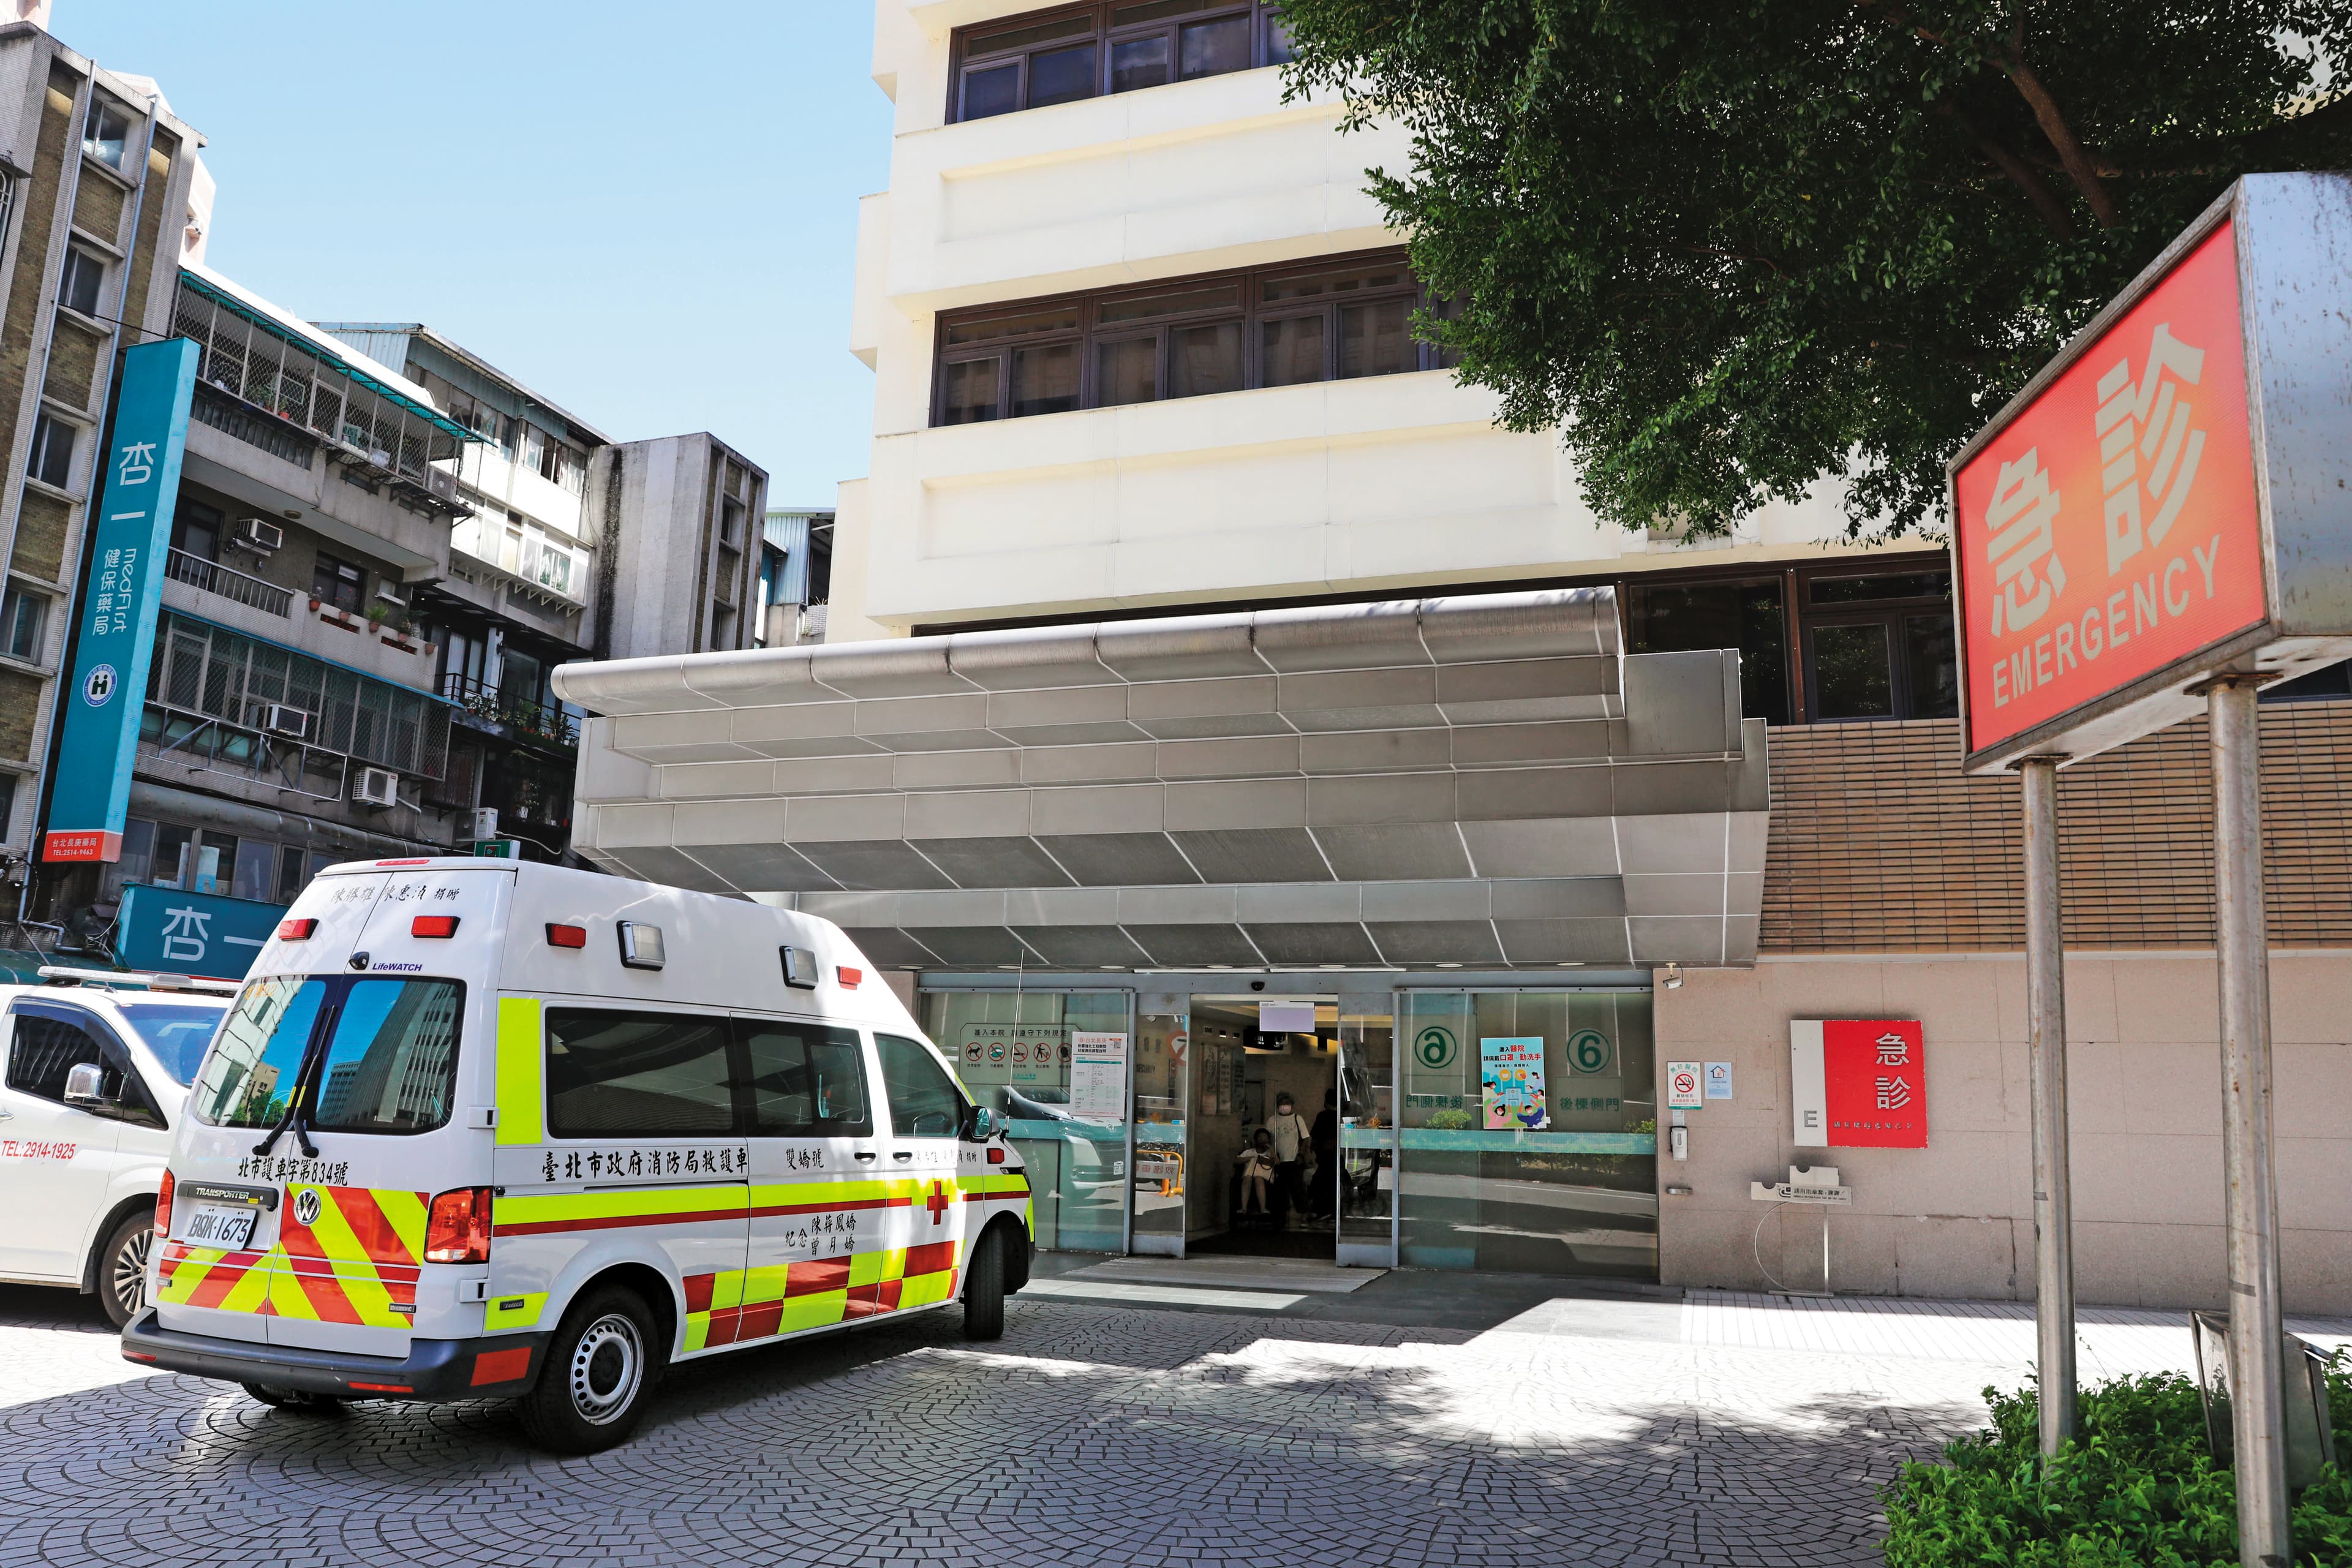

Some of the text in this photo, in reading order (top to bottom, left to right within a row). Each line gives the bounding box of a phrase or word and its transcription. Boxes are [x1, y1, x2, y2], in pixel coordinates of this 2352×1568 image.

[111, 441, 156, 521] 杏一
[1985, 322, 2206, 638] 急診
[92, 549, 121, 636] 健保藥局
[1992, 533, 2222, 709] EMERGENCY
[162, 906, 266, 962] 杏一
[372, 963, 423, 971] LifeWATCH
[1577, 1035, 1600, 1068] 6
[1875, 1033, 1911, 1109] 急診
[1560, 1097, 1619, 1112] 後棟側門
[1, 1140, 76, 1159] TEL:2914-1925
[542, 1147, 748, 1182] 臺北市政府消防局救護車
[786, 1148, 824, 1170] 雙嬌號
[238, 1156, 349, 1186] 北市護車字第834號
[196, 1188, 250, 1199] TRANSPORTER
[785, 1227, 808, 1248] 紀念
